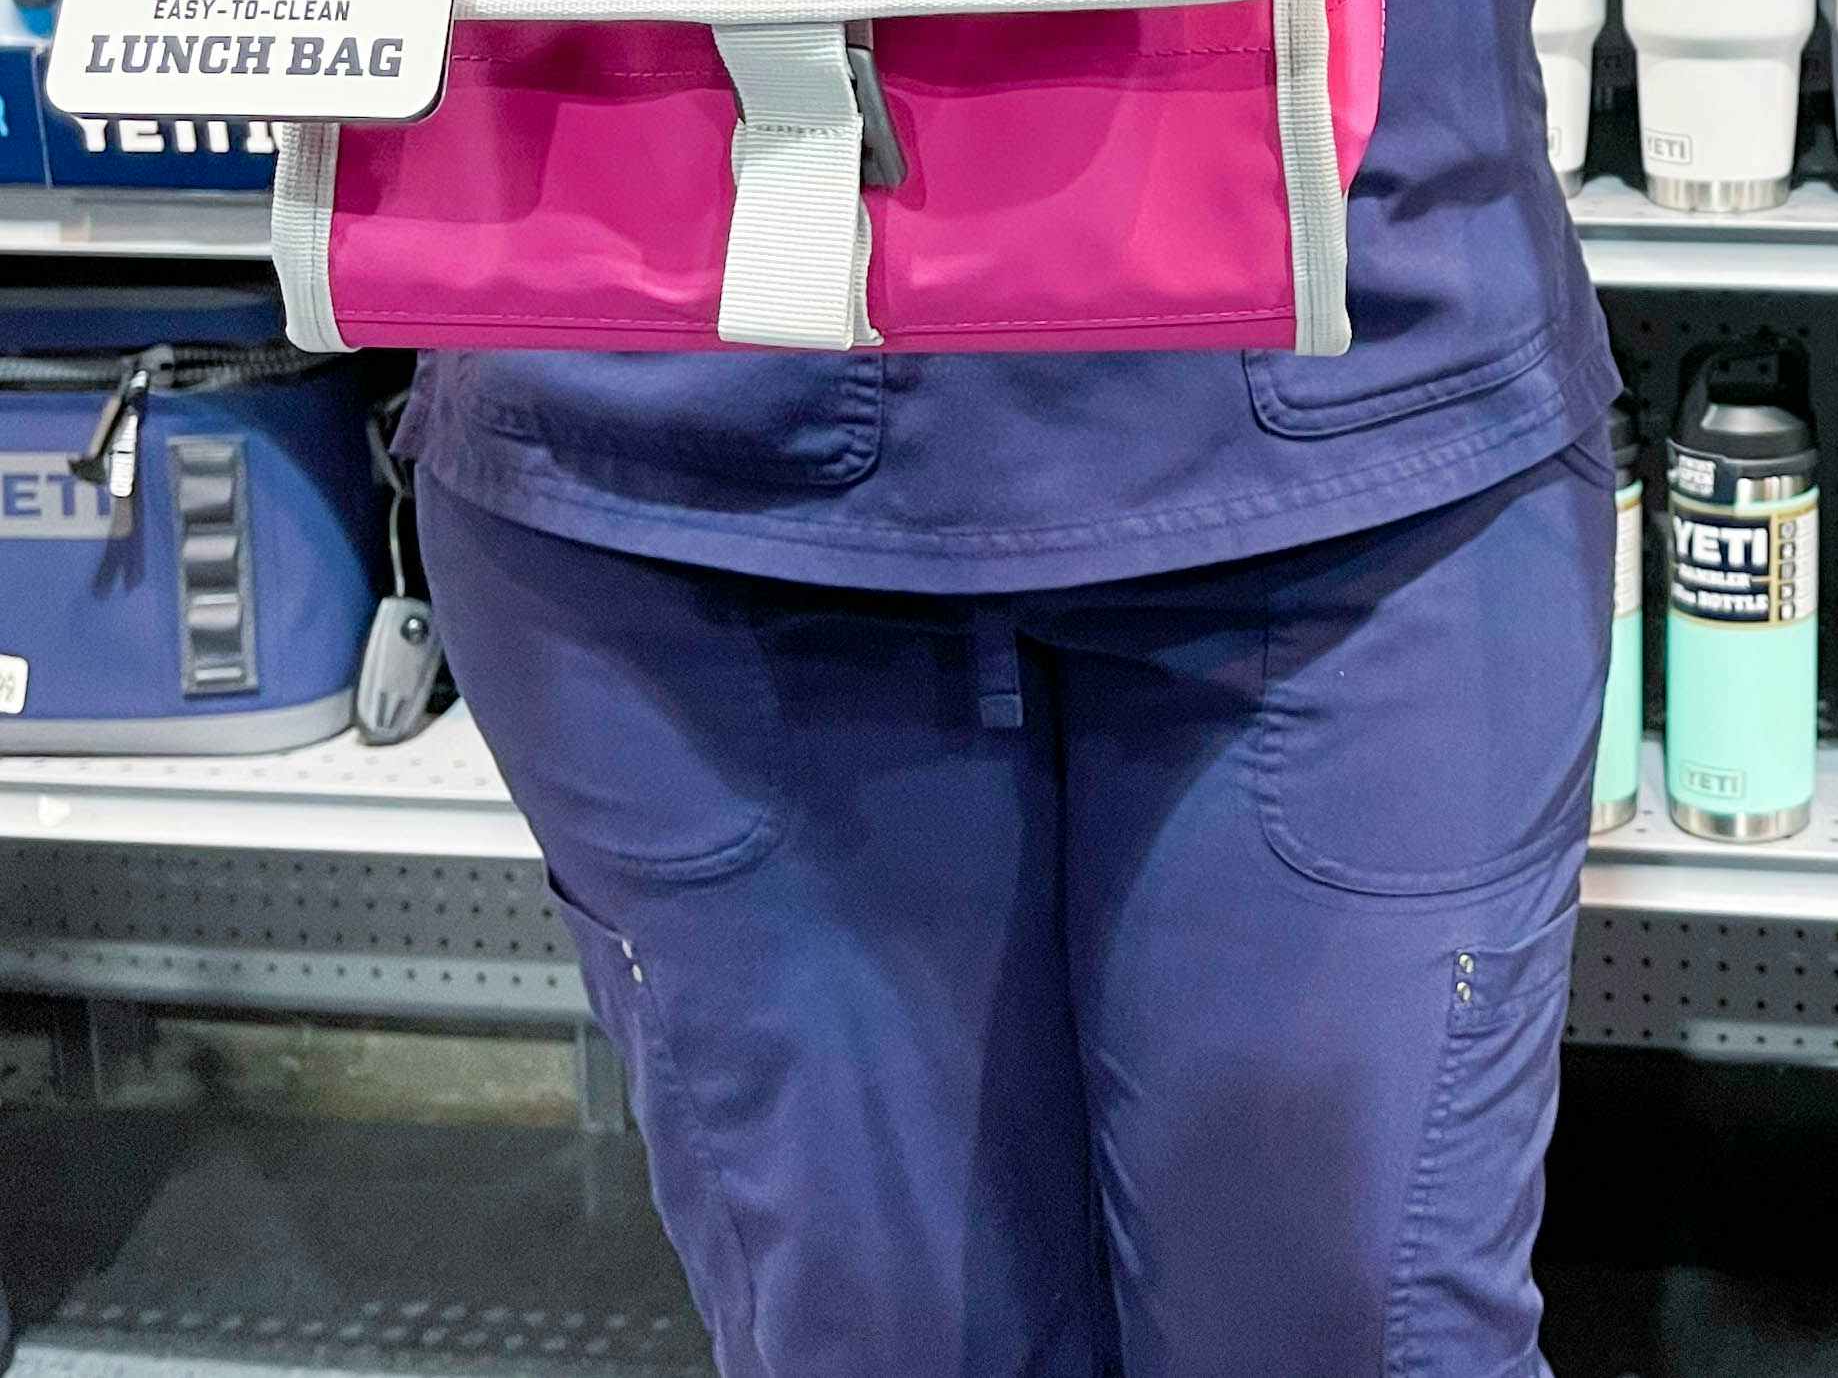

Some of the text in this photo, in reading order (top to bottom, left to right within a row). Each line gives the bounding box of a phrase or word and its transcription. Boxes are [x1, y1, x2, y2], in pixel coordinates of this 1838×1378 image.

[153, 0, 351, 22] EASY-TO-CLEAN
[85, 34, 404, 78] LUNCH BAG
[3, 474, 112, 516] ETI
[1672, 515, 1768, 568] YETI
